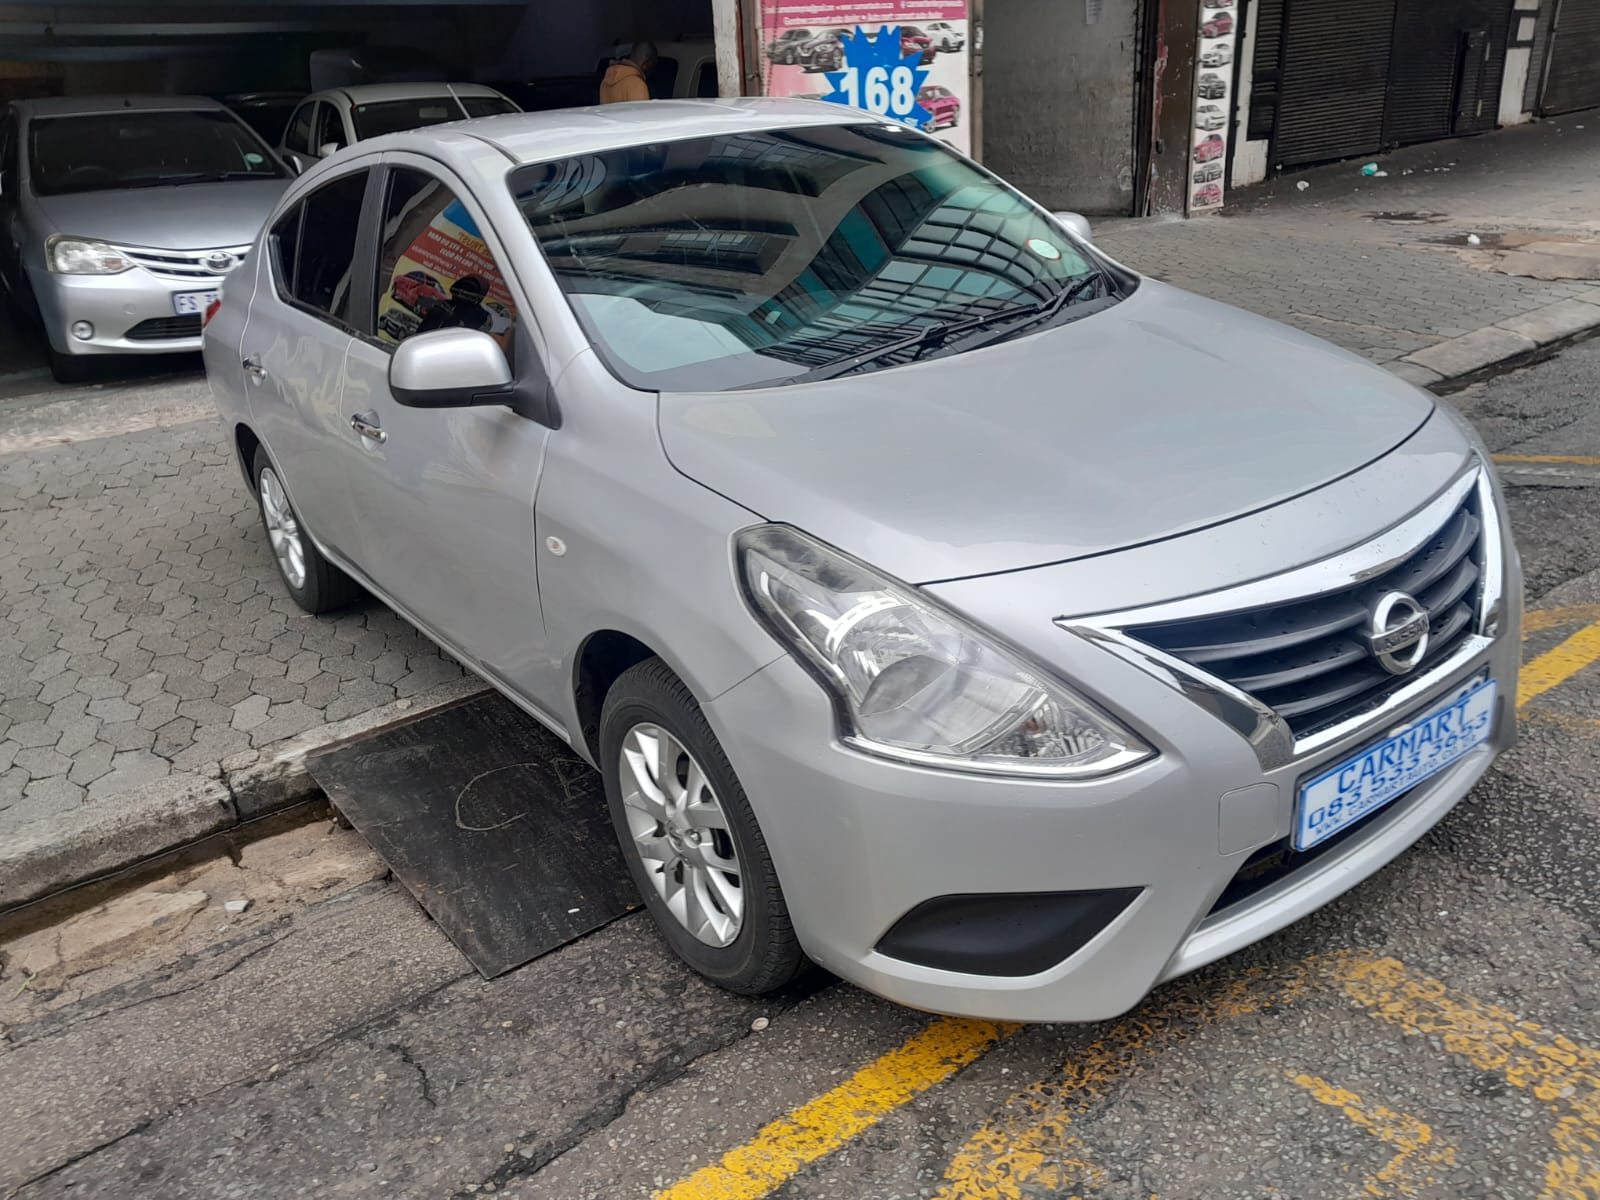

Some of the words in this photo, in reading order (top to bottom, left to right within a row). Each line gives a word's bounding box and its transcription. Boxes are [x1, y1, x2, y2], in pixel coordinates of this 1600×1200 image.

[840, 66, 915, 116] 168
[178, 295, 198, 311] FS
[1308, 785, 1362, 829] 083
[1371, 751, 1421, 792] 533
[1428, 709, 1489, 758] 3653
[1337, 699, 1471, 794] CARMART
